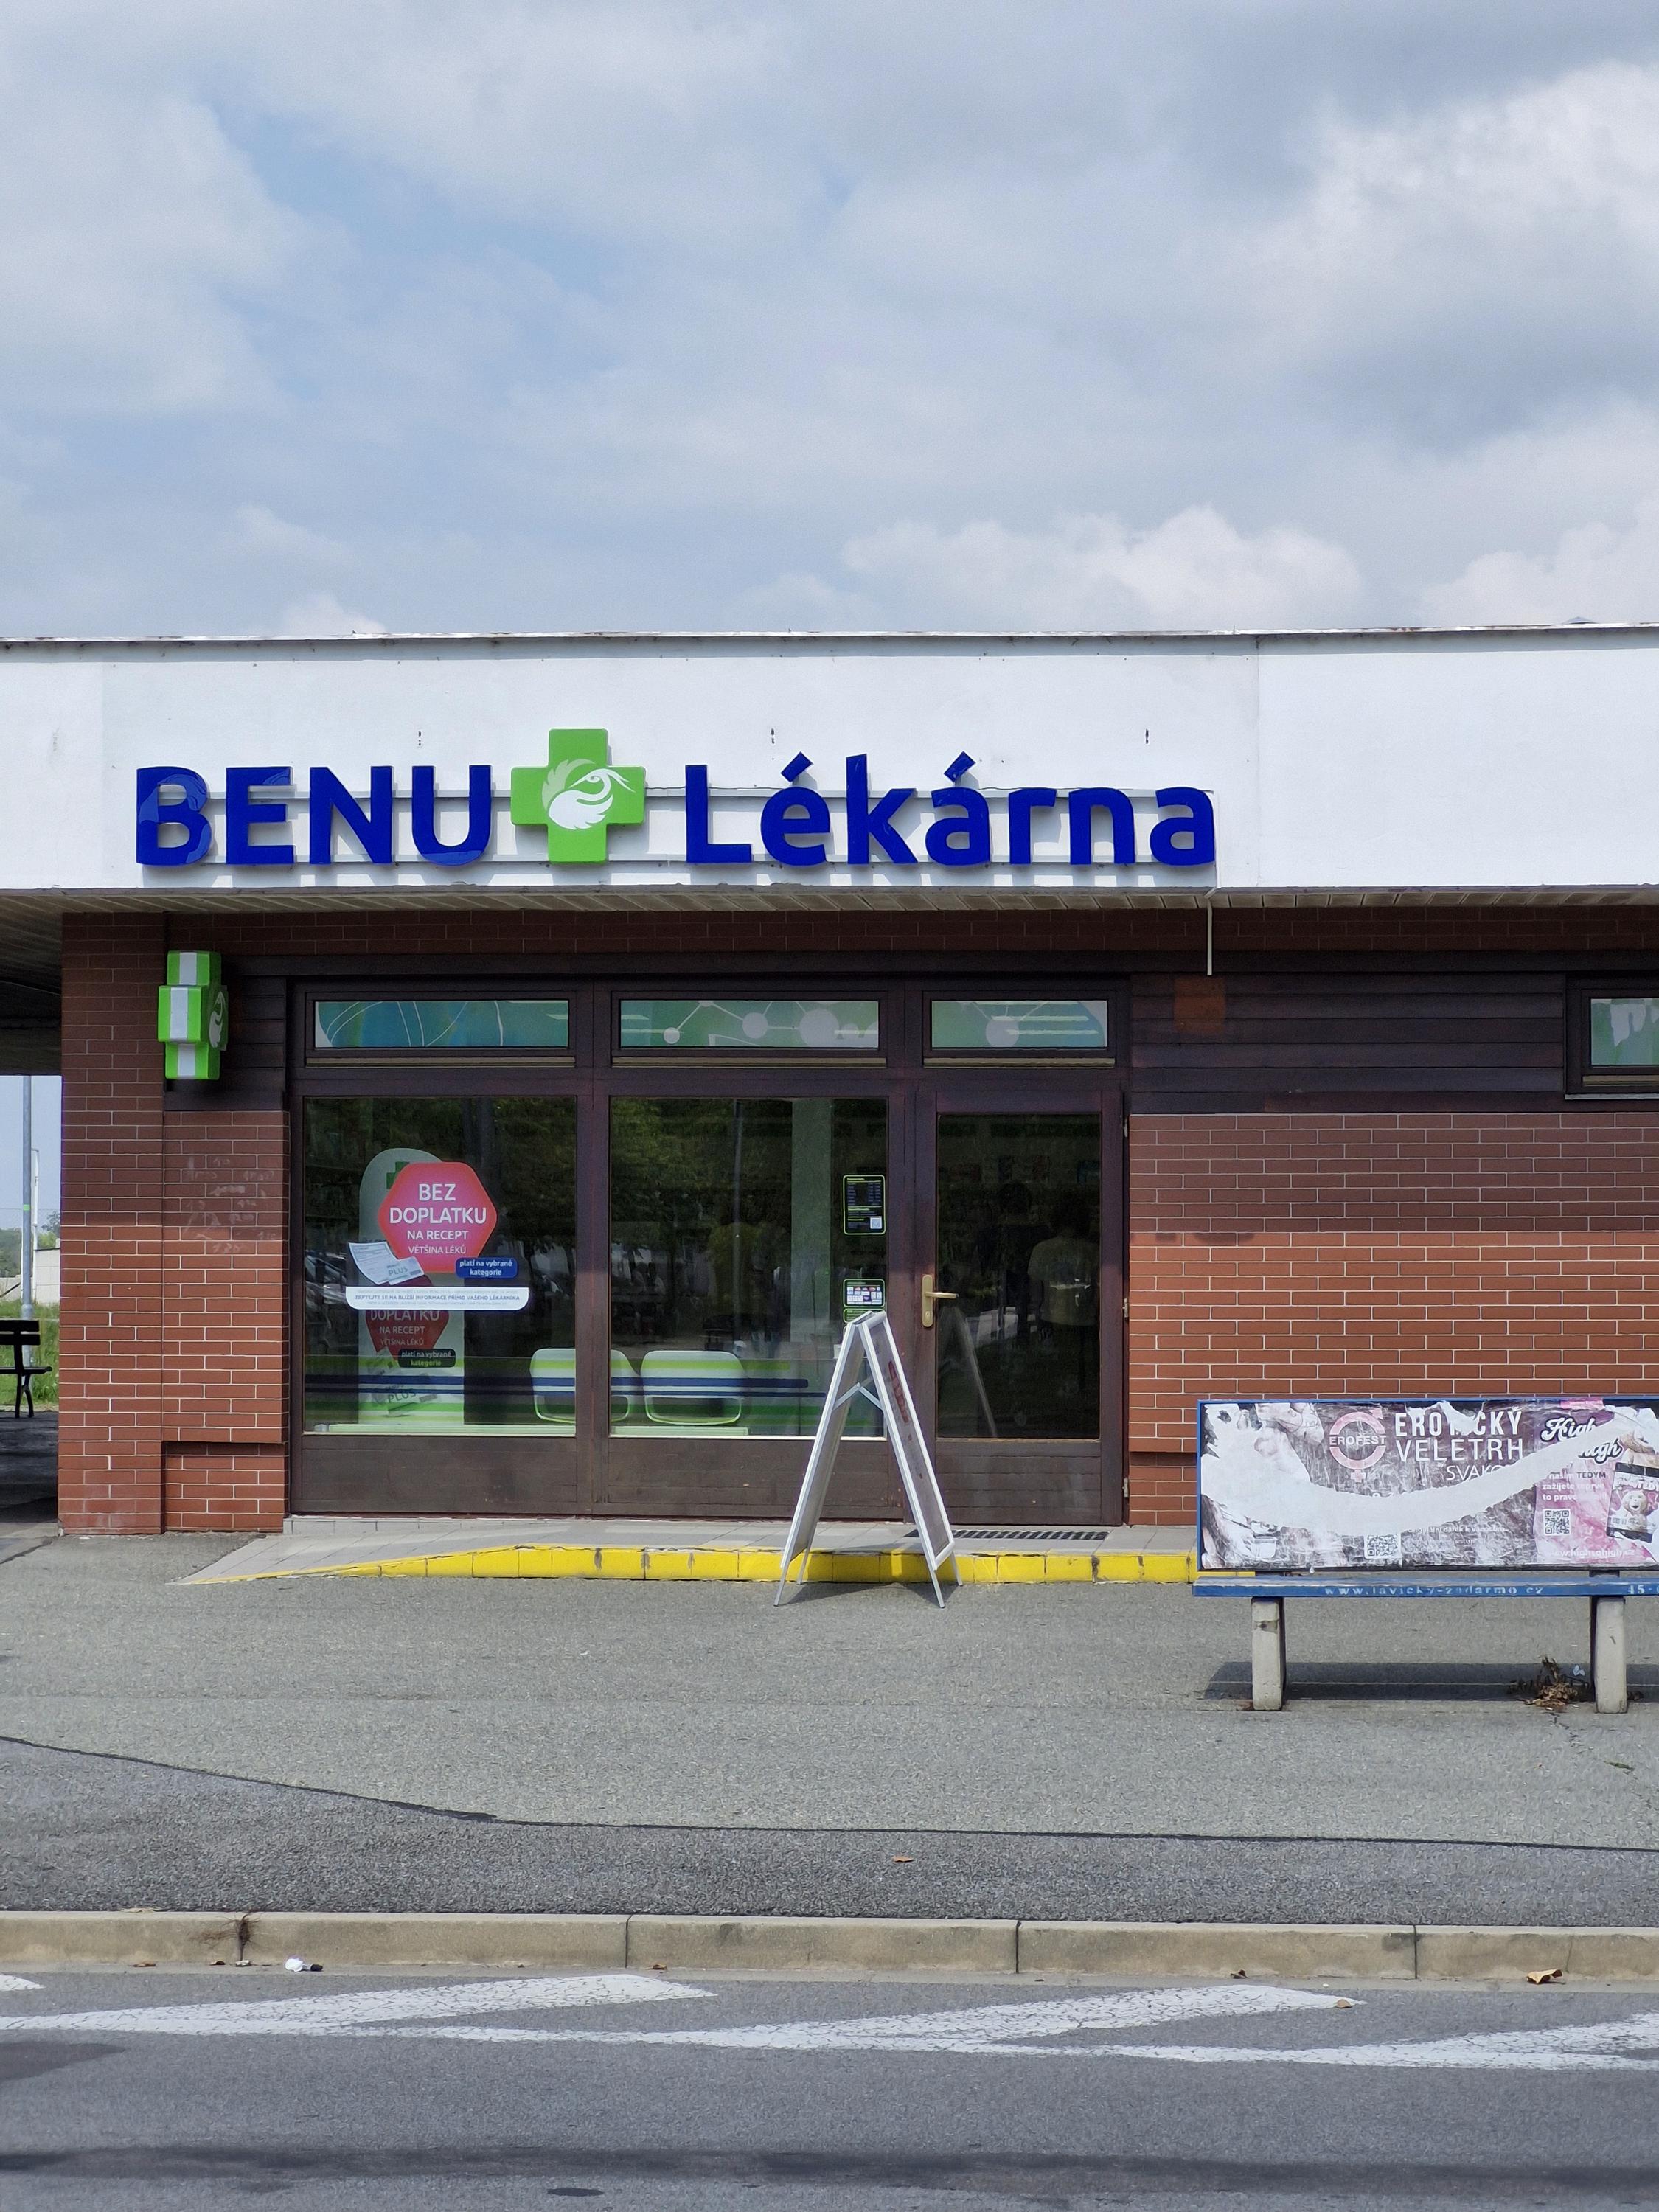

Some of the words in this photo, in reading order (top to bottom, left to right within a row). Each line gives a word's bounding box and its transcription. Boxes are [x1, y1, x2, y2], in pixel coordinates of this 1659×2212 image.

[136, 765, 492, 866] BENU
[685, 751, 1216, 866] Lékárna
[418, 1183, 456, 1201] BEZ
[389, 1207, 487, 1224] DOPLATKU
[407, 1230, 423, 1240] NA
[426, 1230, 469, 1240] RECEPT
[408, 1244, 444, 1254] VĚTŠINA
[485, 1259, 513, 1268] vybrané
[388, 1266, 409, 1276] PLUS
[470, 1268, 502, 1277] kategorie
[370, 1310, 440, 1321] DOPLATKU
[379, 1326, 391, 1334] NA
[392, 1326, 425, 1334] RECEPT
[1329, 1434, 1387, 1446] EROFEST
[1395, 1438, 1523, 1463] VELETRH
[1576, 1471, 1607, 1479] TEDYM
